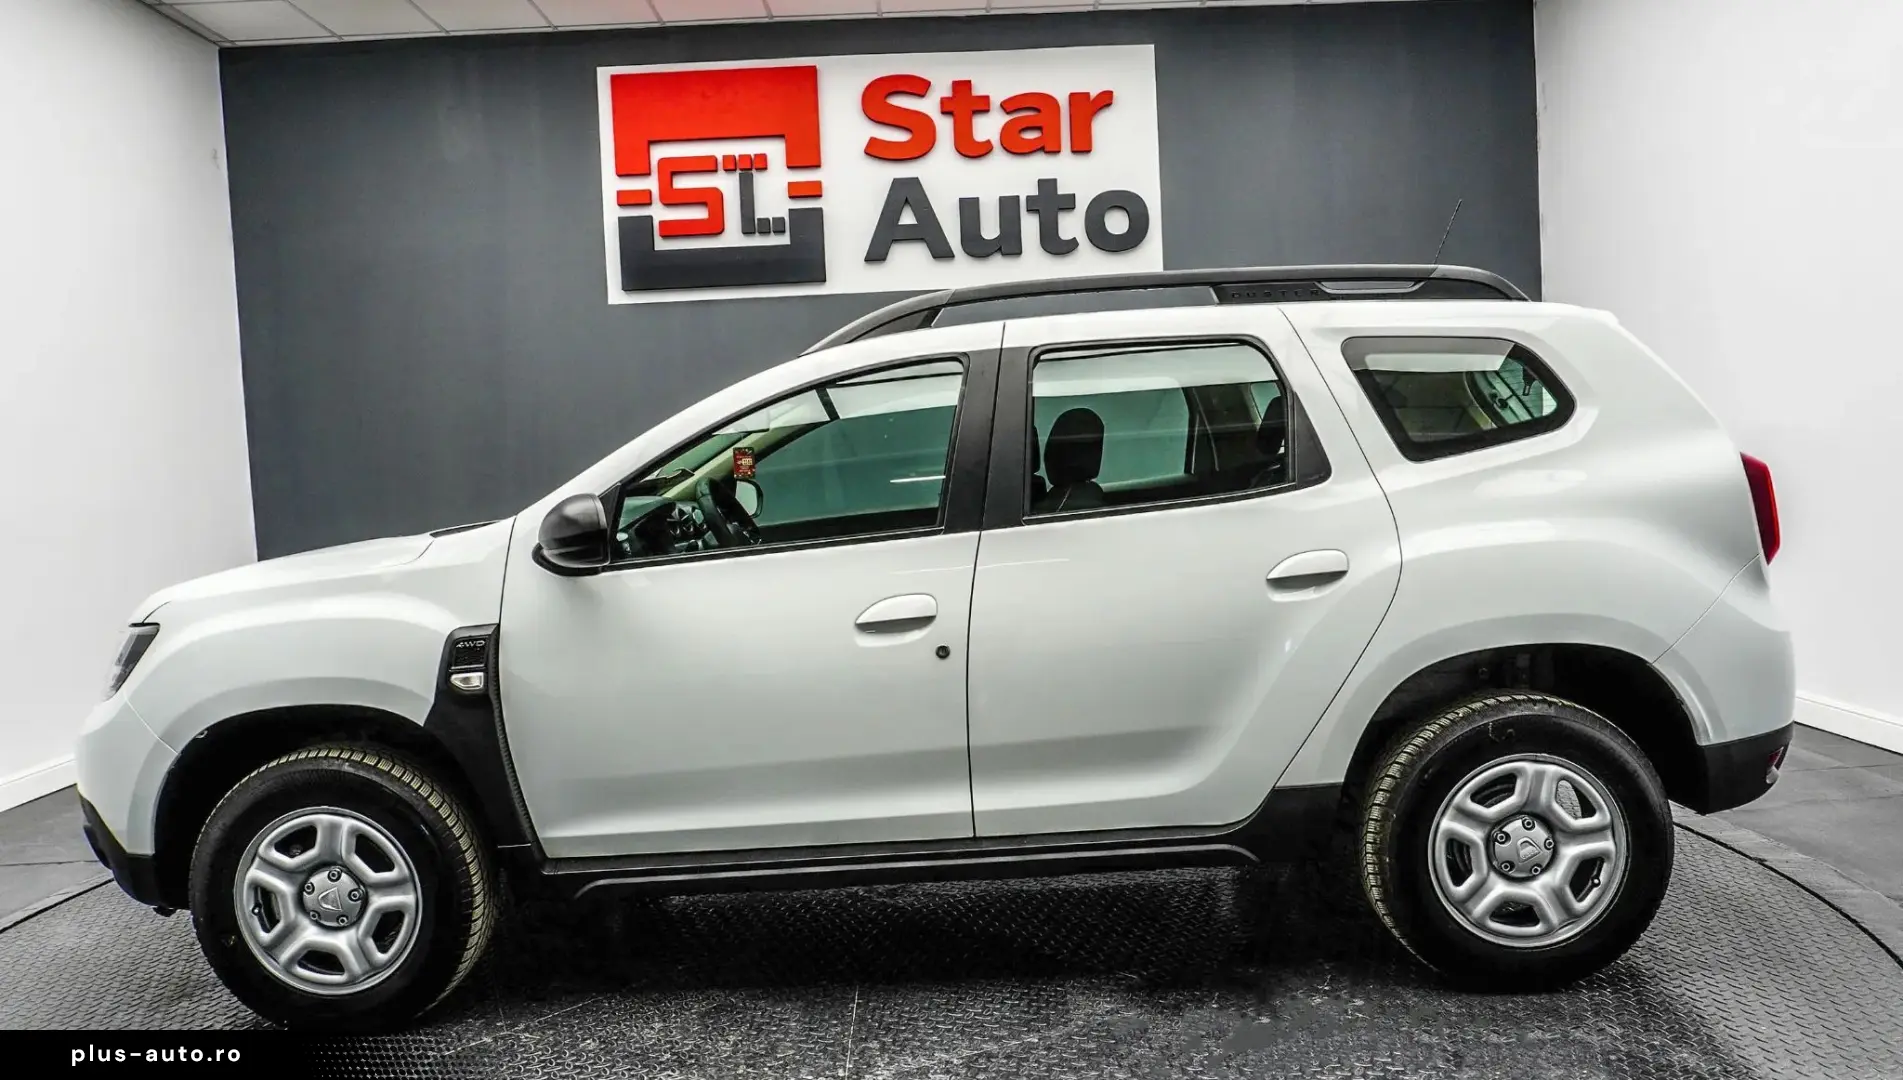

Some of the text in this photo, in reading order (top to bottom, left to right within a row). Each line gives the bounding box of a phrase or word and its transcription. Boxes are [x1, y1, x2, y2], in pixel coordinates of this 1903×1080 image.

[861, 74, 1114, 161] Star
[864, 177, 1150, 262] Auto
[455, 640, 486, 649] 4WD
